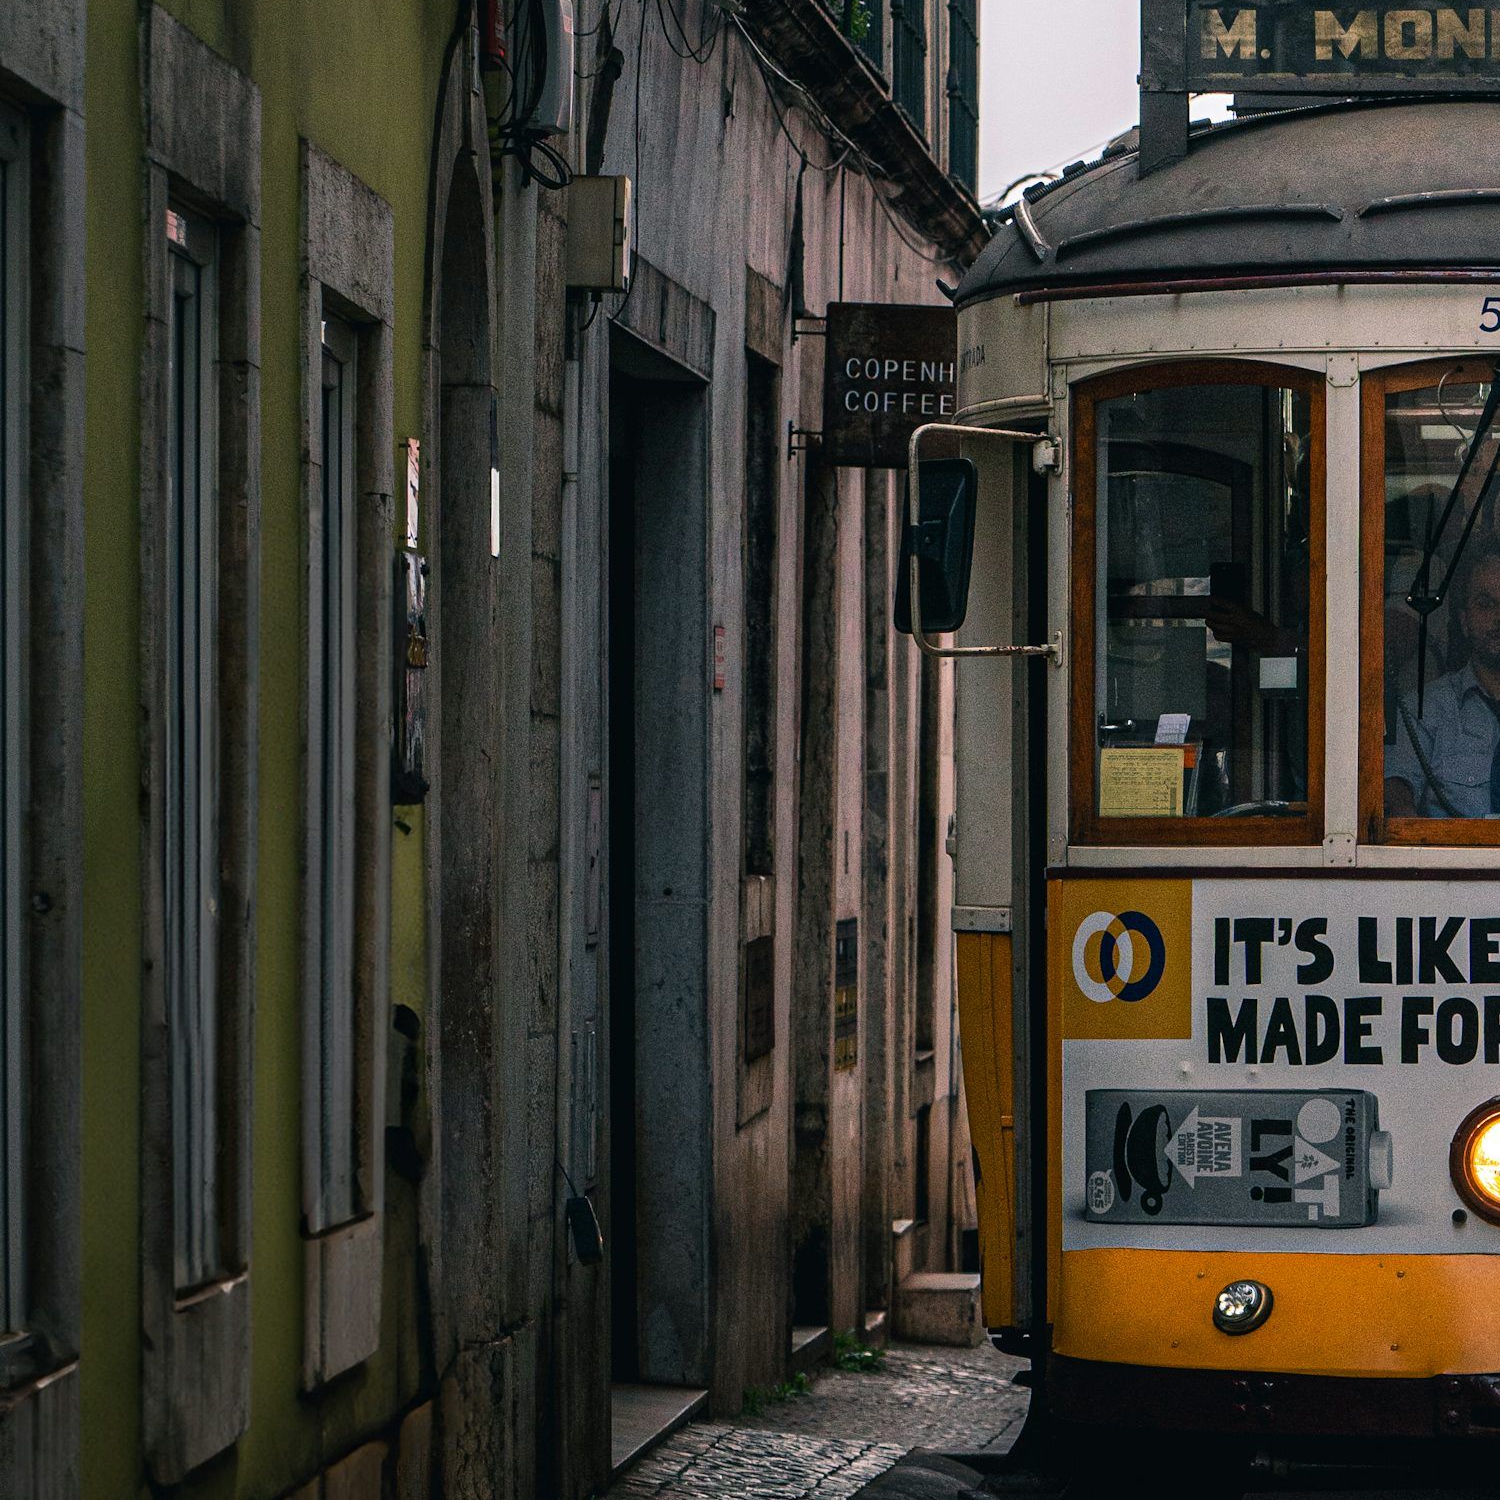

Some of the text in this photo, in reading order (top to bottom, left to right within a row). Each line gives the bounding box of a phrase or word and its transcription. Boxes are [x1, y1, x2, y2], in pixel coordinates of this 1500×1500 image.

[1199, 8, 1271, 60] M.
[845, 357, 954, 384] COPENH
[844, 390, 953, 416] COFFEE
[1213, 915, 1335, 986] IT'S
[1206, 994, 1384, 1066] MADE
[1177, 1132, 1187, 1166] EDITION
[1185, 1131, 1196, 1167] BARISTA
[1196, 1120, 1214, 1174] AVOINE
[1213, 1120, 1232, 1173] AVENA
[1249, 1118, 1293, 1204] LY!
[1344, 1098, 1356, 1180] THE ORIGINAL
